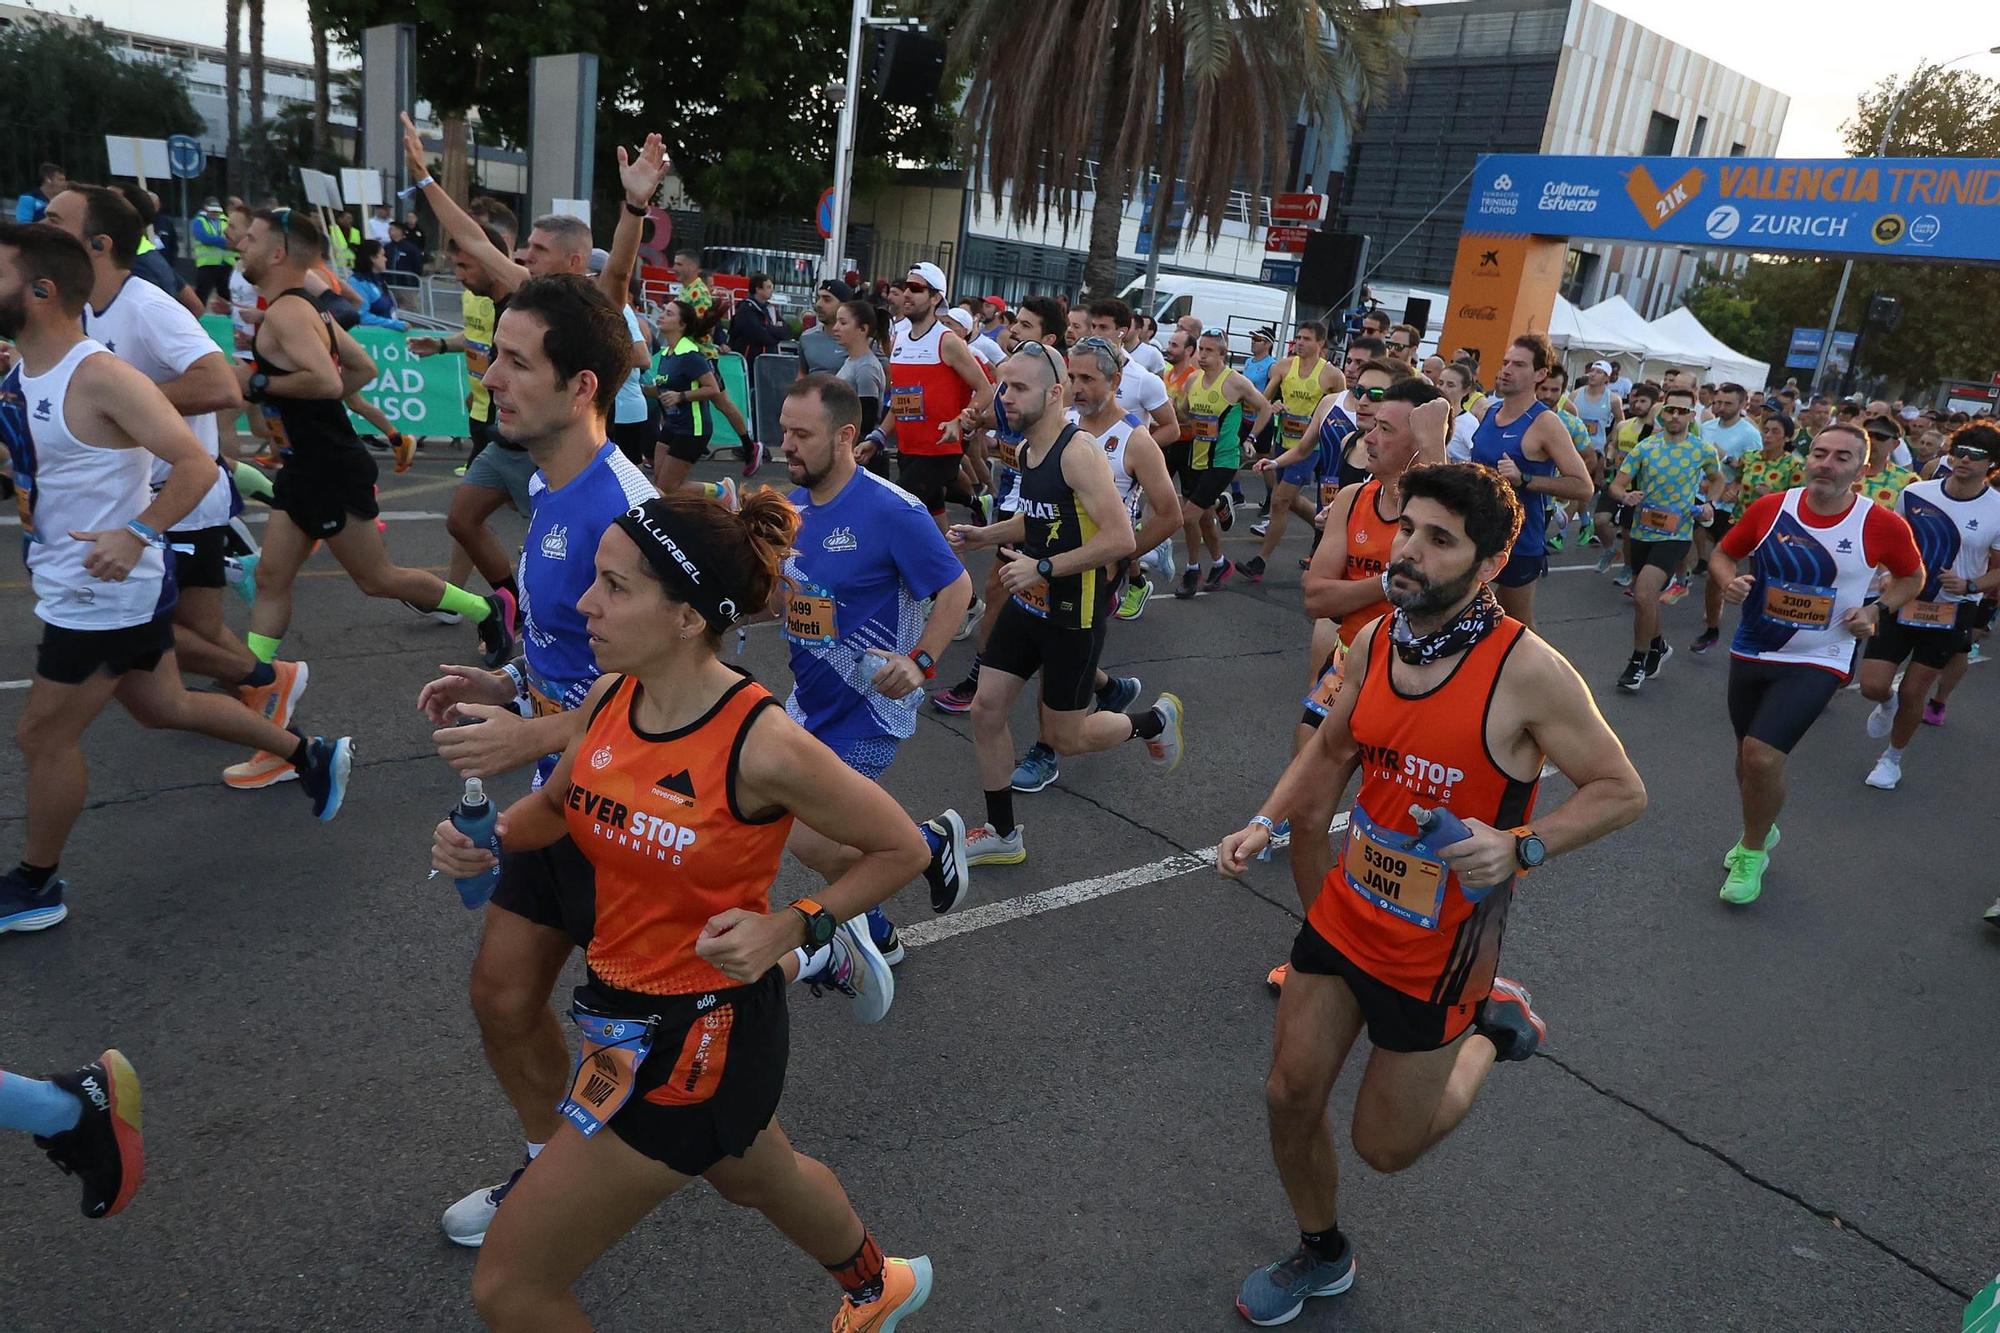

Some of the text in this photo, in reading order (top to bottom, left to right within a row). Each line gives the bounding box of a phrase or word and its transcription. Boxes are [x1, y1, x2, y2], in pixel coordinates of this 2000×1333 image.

[1543, 181, 1589, 197] Cultura
[1718, 165, 1880, 202] VALENCIA
[1479, 207, 1516, 215] ALFONSO
[1538, 196, 1597, 212] Esfuerzo
[1655, 184, 1688, 219] 21K
[1748, 214, 1849, 238] ZURICH
[642, 519, 701, 585] LURBEL
[1404, 754, 1465, 788] STOP
[593, 823, 682, 866] RUNNING
[629, 811, 698, 853] STOP
[1364, 845, 1407, 878] 5309
[1362, 869, 1401, 900] JAVI
[697, 994, 717, 1010] edp
[80, 1075, 111, 1111] HOKA
